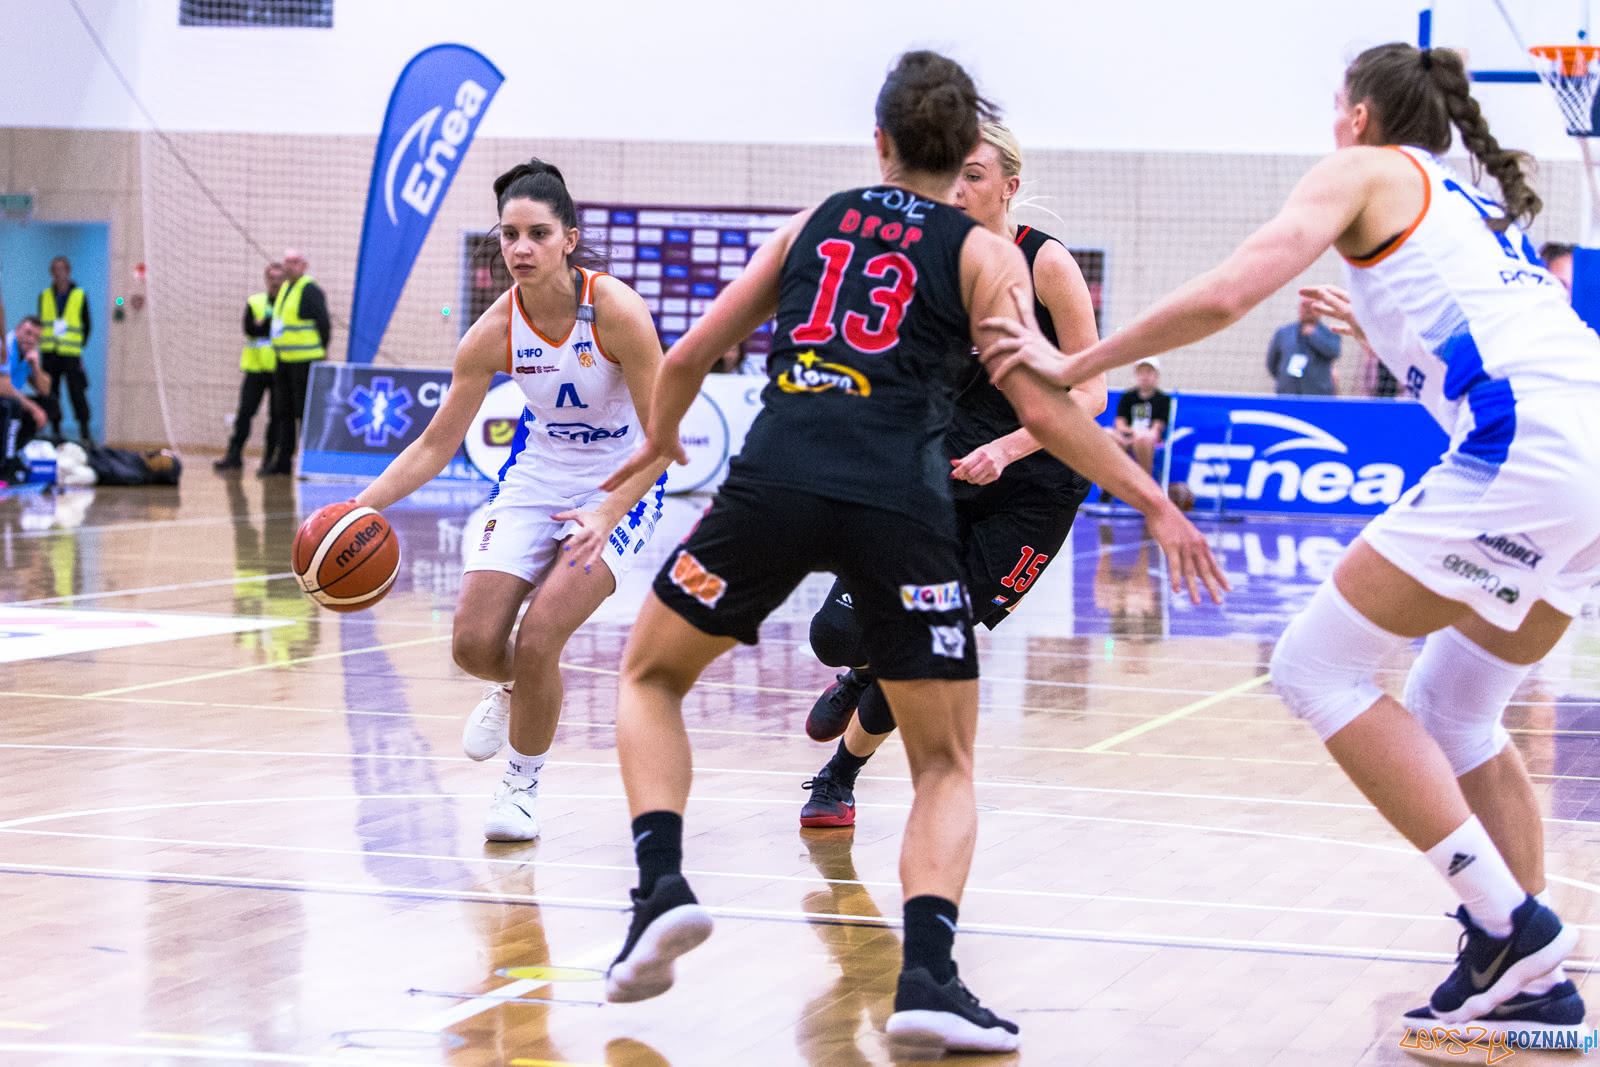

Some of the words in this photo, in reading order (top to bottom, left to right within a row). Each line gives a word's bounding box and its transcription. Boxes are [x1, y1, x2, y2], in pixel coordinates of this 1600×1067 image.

[402, 79, 488, 216] Enea
[839, 208, 923, 249] DROP
[790, 238, 918, 353] 13
[1186, 443, 1406, 506] Enea
[335, 520, 384, 568] molten
[1001, 545, 1049, 593] 15
